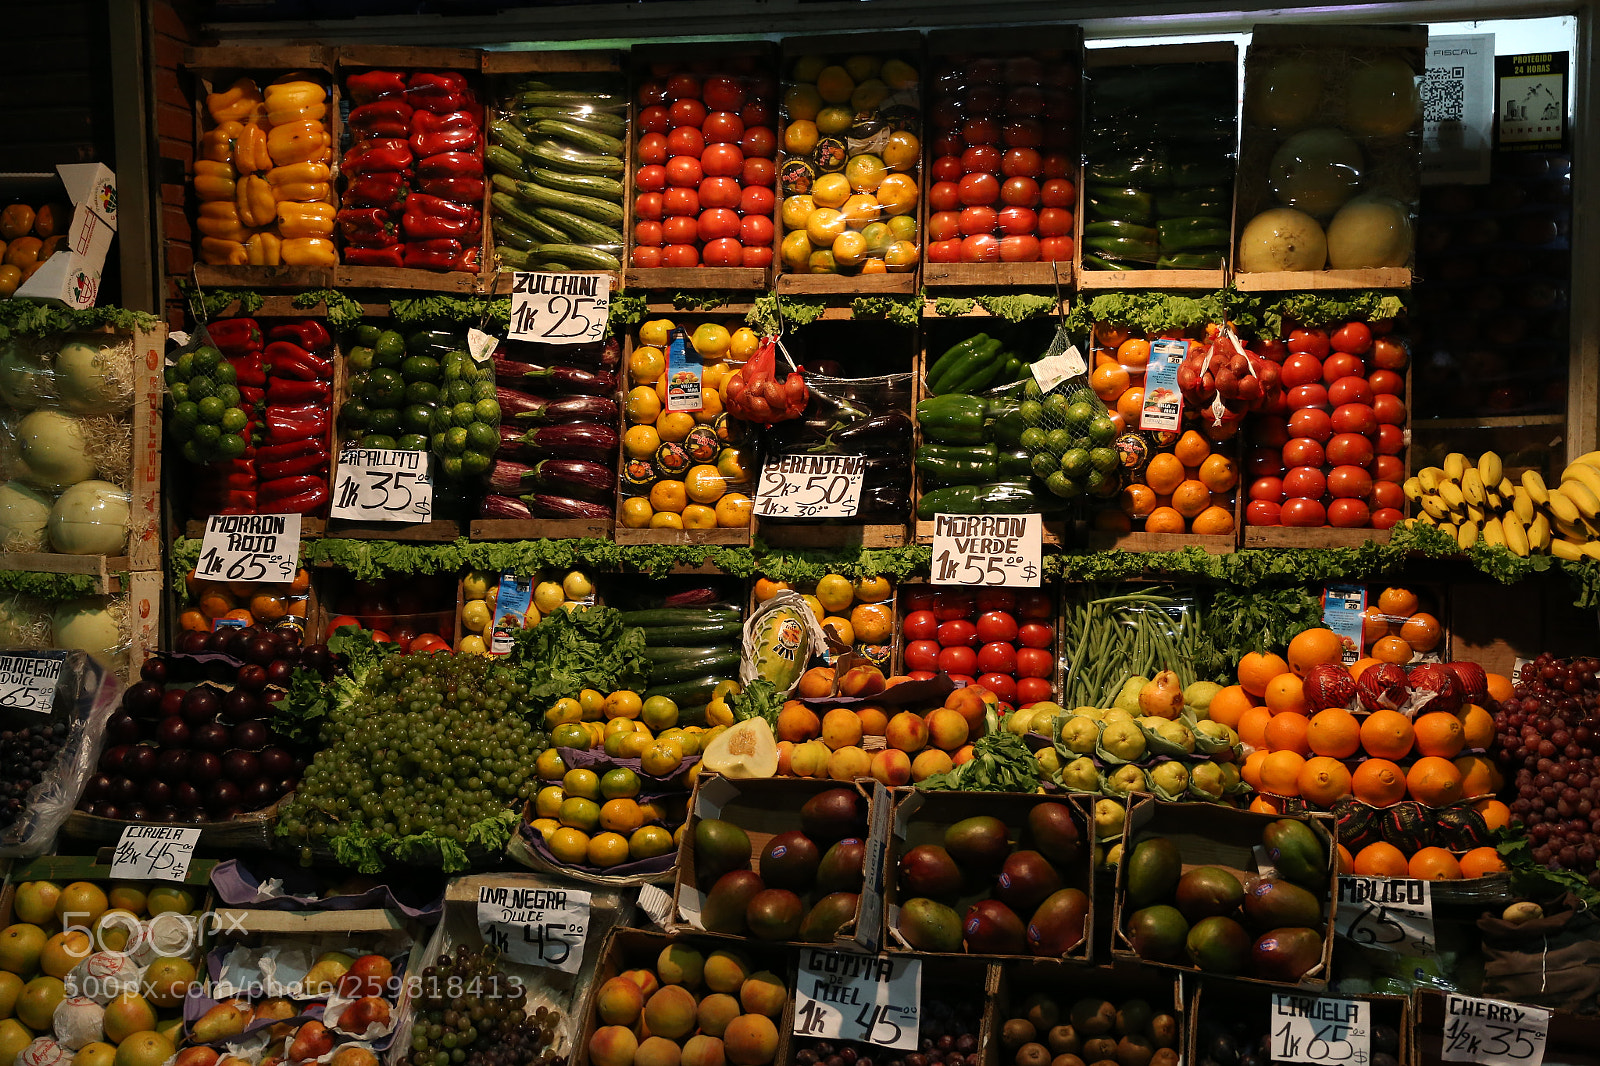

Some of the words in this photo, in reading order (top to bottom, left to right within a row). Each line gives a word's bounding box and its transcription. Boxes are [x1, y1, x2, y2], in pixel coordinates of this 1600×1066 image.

[1513, 54, 1553, 64] PROTEGIDO
[1514, 65, 1524, 74] 24
[1527, 64, 1551, 73] HORAS
[512, 273, 600, 296] ZUCCHINI
[147, 376, 157, 482] Estrada
[339, 449, 420, 469] ZAPALLITO
[763, 455, 865, 475] BERENJENA
[210, 516, 285, 534] MORRON
[936, 516, 1026, 537] MORRON
[227, 533, 277, 552] ROJO
[954, 538, 1018, 554] VERDE
[11, 658, 62, 679] NEGRA
[0, 672, 34, 686] DULCE
[126, 827, 184, 840] CIRUELA
[506, 889, 567, 910] NEGRA
[1322, 877, 1424, 905] MBLIGO
[498, 909, 544, 923] DULCE
[808, 949, 894, 982] GOTITA
[829, 974, 843, 984] DE
[812, 979, 861, 1006] MIEL
[1277, 994, 1359, 1024] CIRUELA
[1450, 998, 1526, 1024] CHERRY
